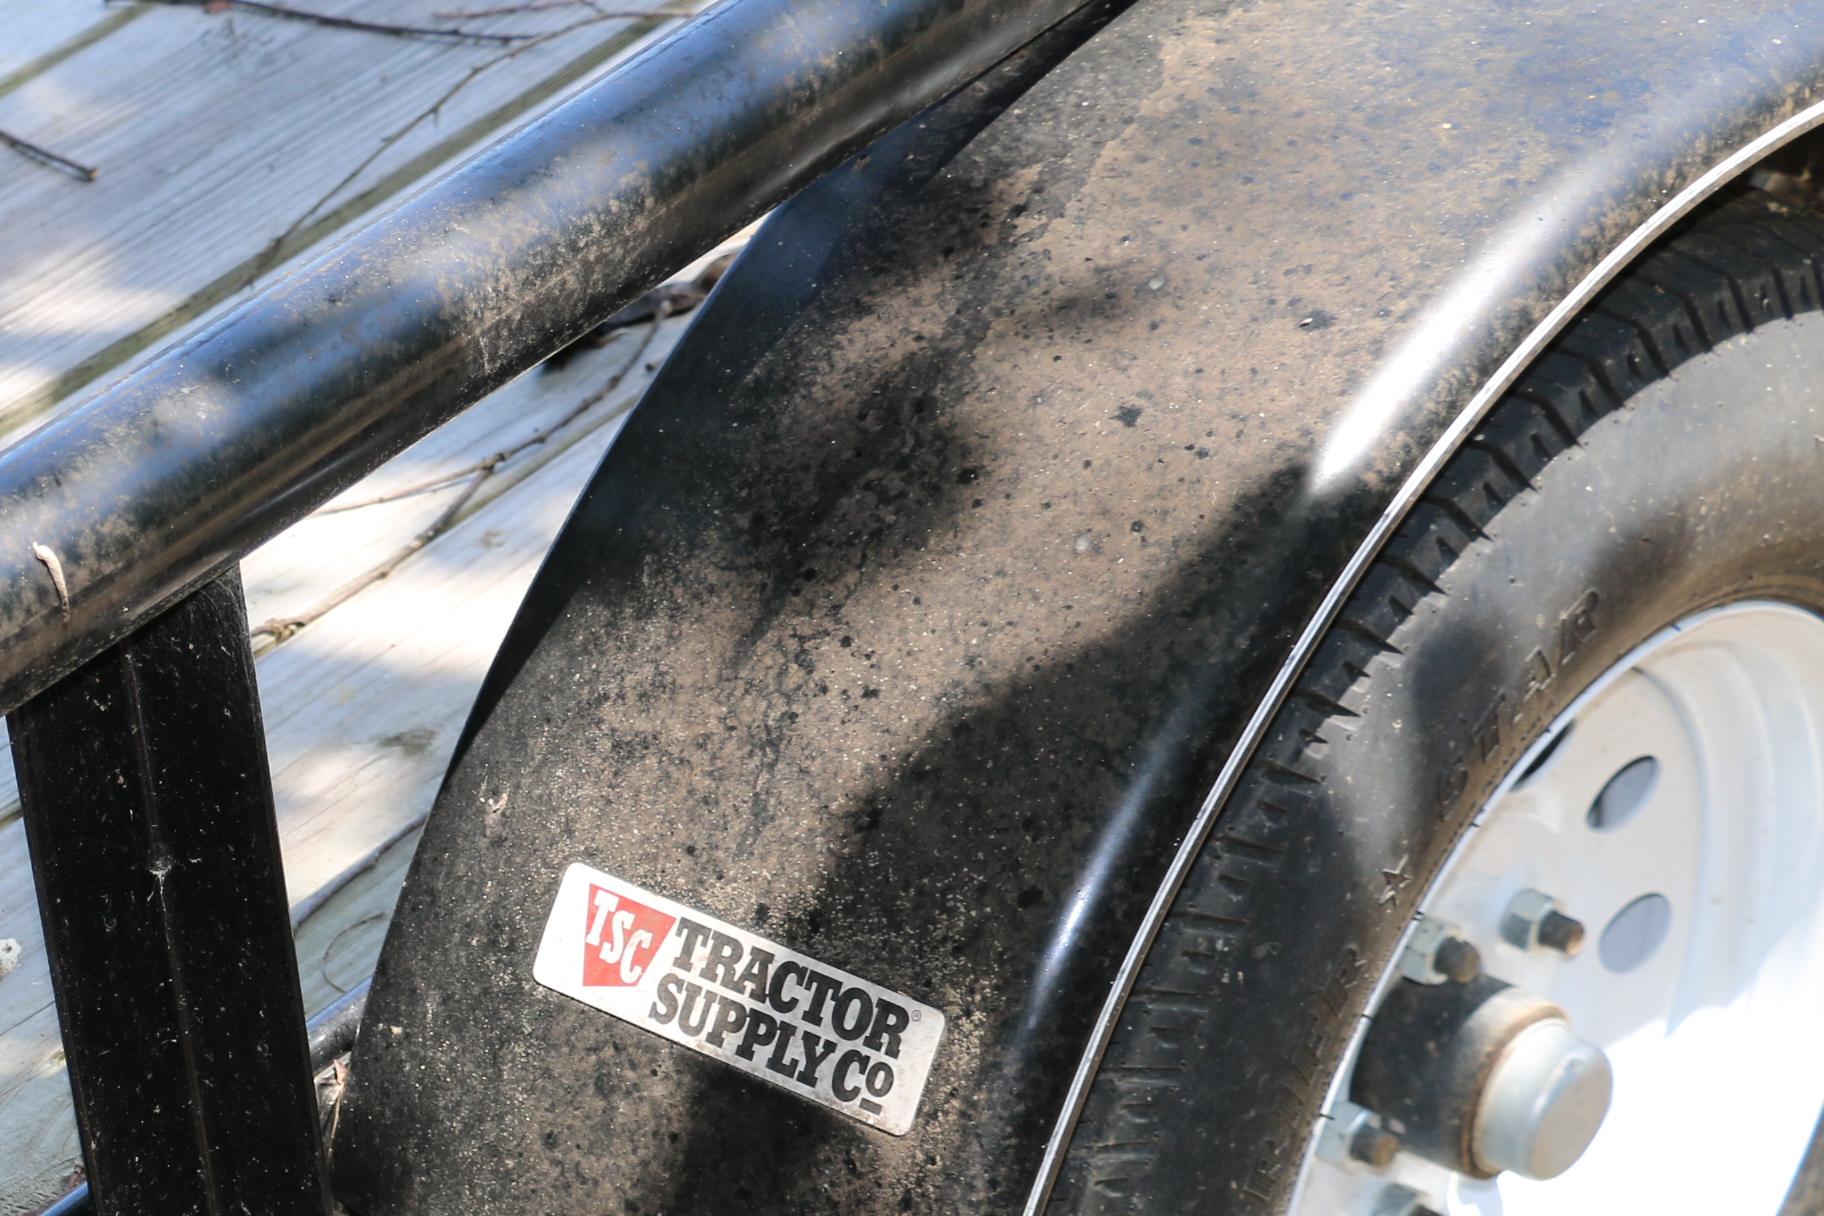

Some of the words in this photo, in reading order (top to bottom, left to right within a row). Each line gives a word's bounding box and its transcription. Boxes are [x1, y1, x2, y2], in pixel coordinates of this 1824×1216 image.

[586, 888, 653, 984] TSC
[670, 916, 910, 1058] TRACTOR
[648, 972, 836, 1088] SUPPLY
